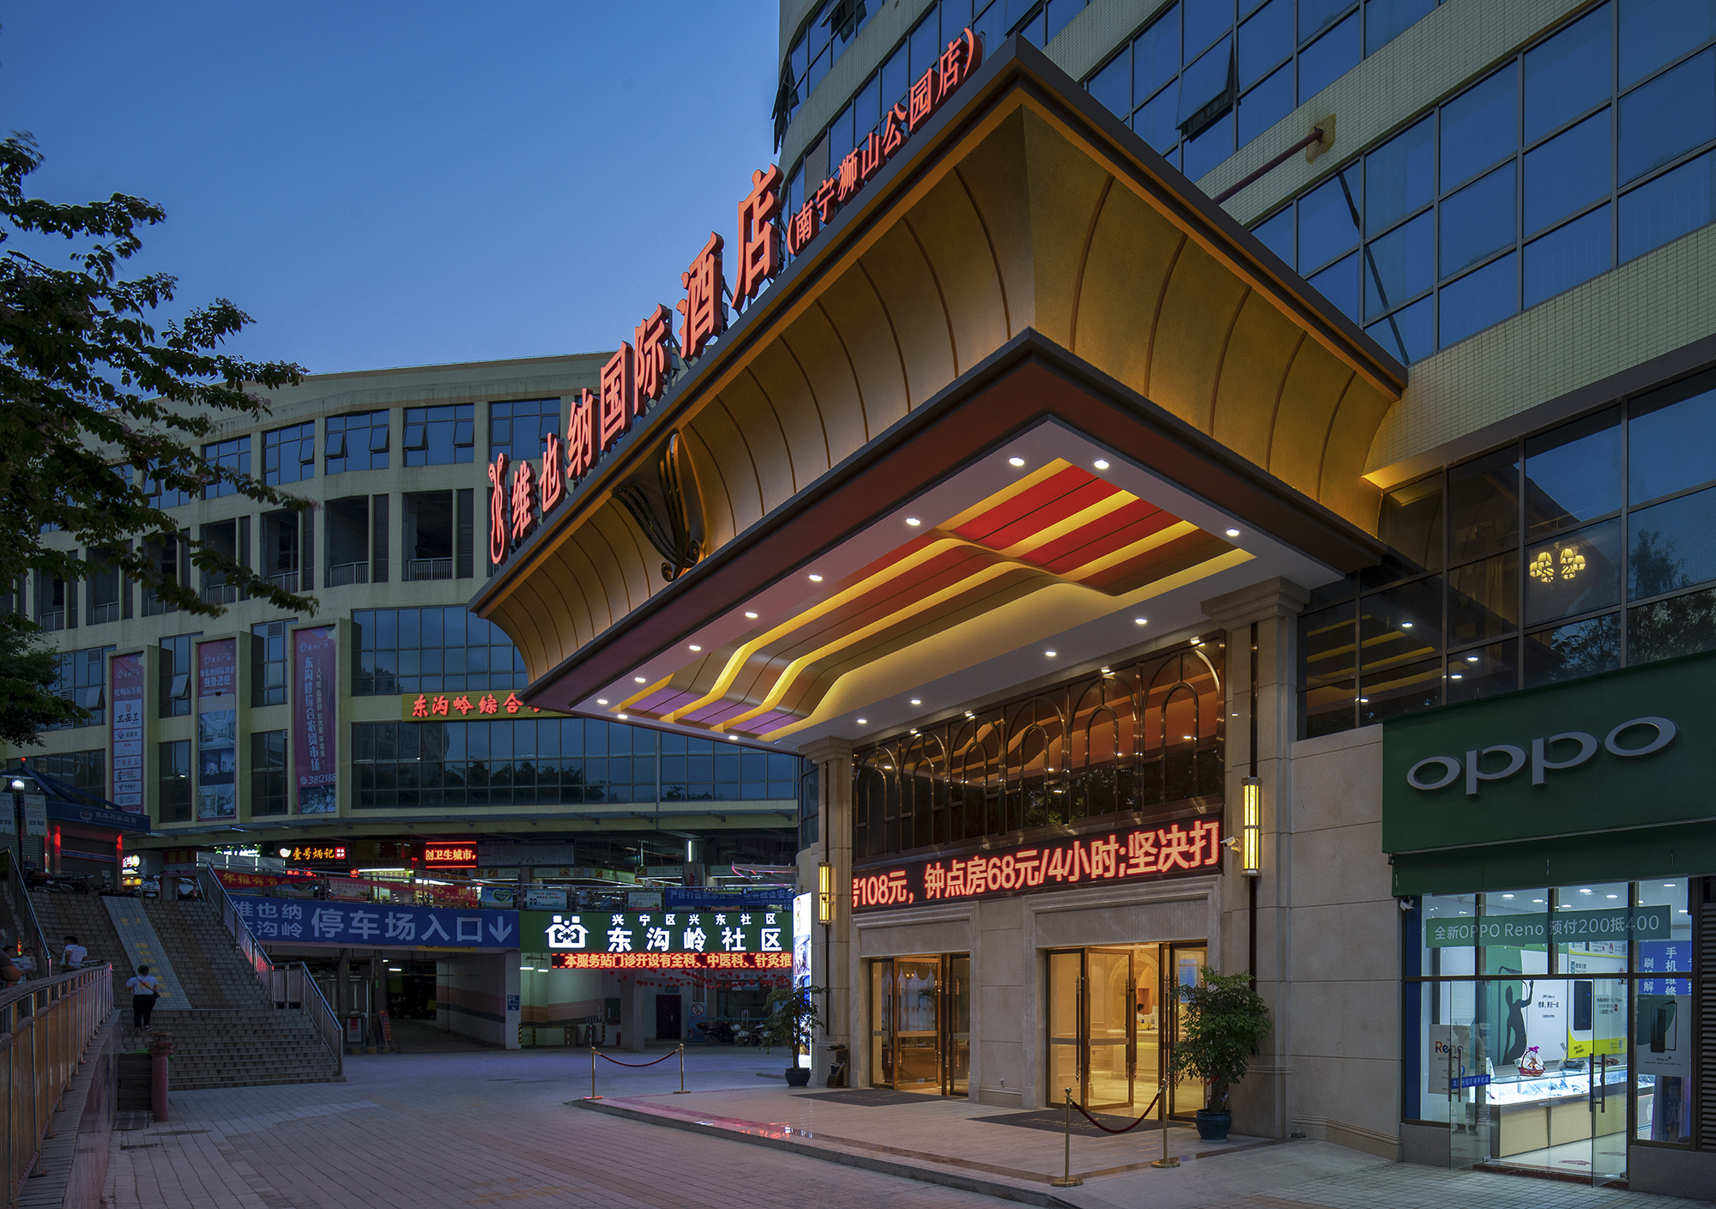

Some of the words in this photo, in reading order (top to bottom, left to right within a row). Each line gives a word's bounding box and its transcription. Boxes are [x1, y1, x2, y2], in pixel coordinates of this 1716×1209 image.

[511, 163, 783, 540] 维也纳国际酒店
[412, 692, 541, 718] 东沟岭综合
[310, 908, 484, 943] 停车场入口
[611, 913, 777, 926] 兴宁区兴东社区
[1434, 922, 1501, 941] 全新OPPO
[1504, 921, 1545, 937] Reno
[1549, 914, 1660, 937] 预付200抵400
[606, 926, 783, 953] 东沟岭社区
